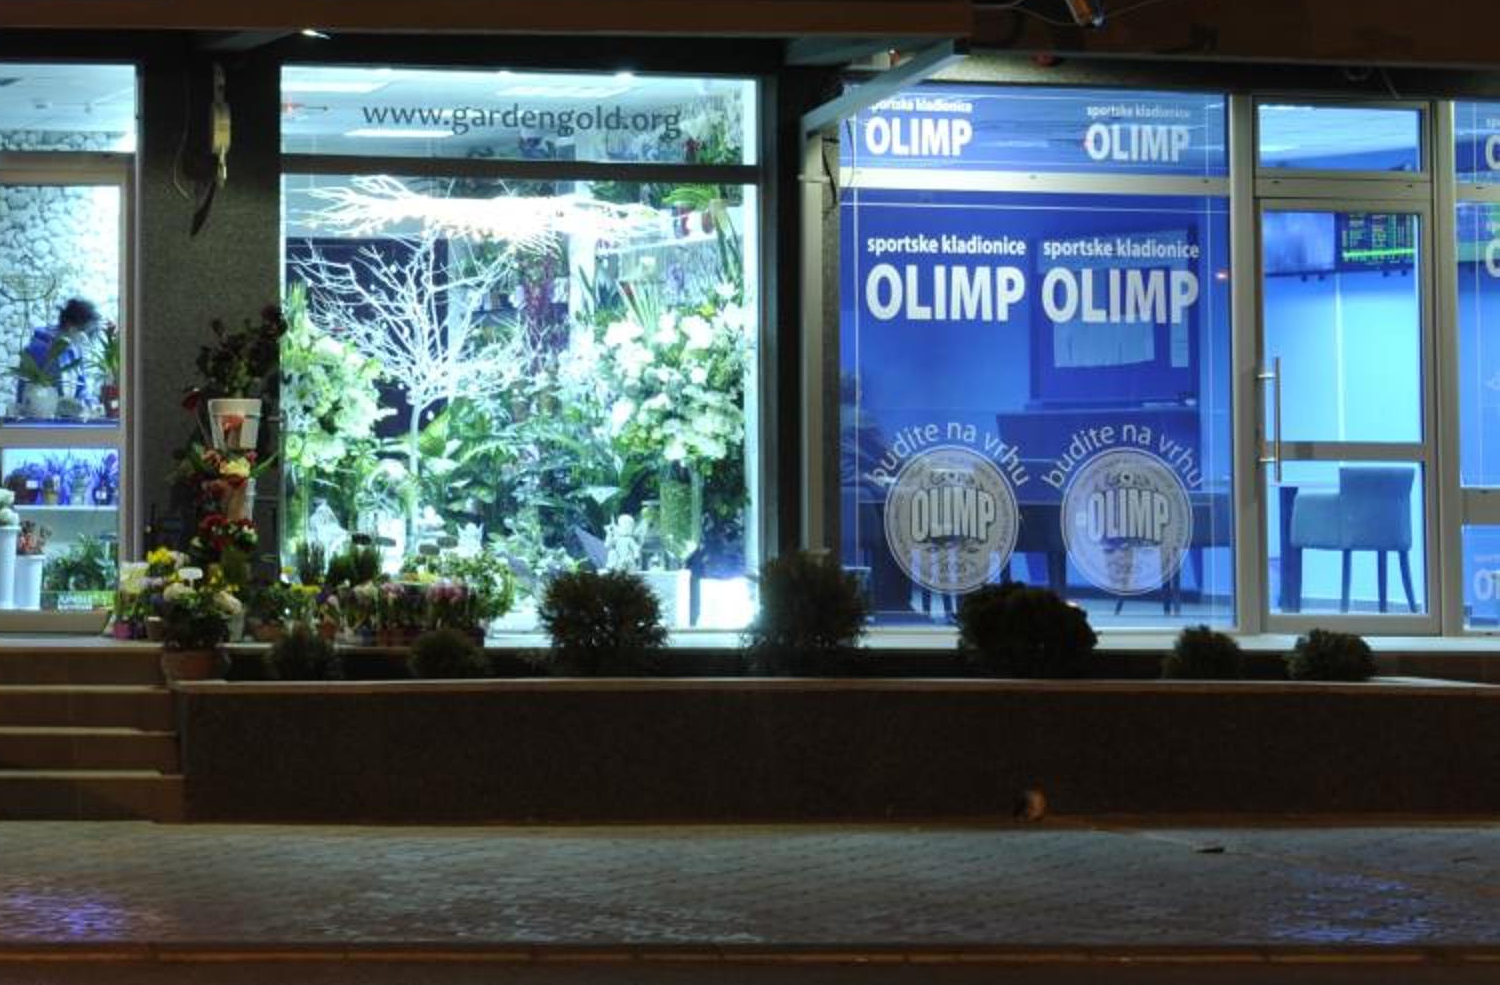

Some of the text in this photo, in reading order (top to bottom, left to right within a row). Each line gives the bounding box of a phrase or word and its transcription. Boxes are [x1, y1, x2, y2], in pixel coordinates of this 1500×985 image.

[362, 103, 682, 139] www.gardengold.org
[865, 116, 973, 156] OLIMP
[1087, 105, 1133, 120] sportske
[1085, 123, 1190, 162] OLIMP
[867, 234, 1026, 256] sportske kladionice
[1043, 238, 1200, 260] sportske kladionice
[865, 263, 1026, 322] OLIMP
[1041, 266, 1199, 324] OLIMP
[864, 421, 1031, 488] budite na vrhu
[1040, 423, 1205, 489] budite na vrhu
[911, 487, 996, 543] OLIMP
[1087, 487, 1170, 543] OLIMP
